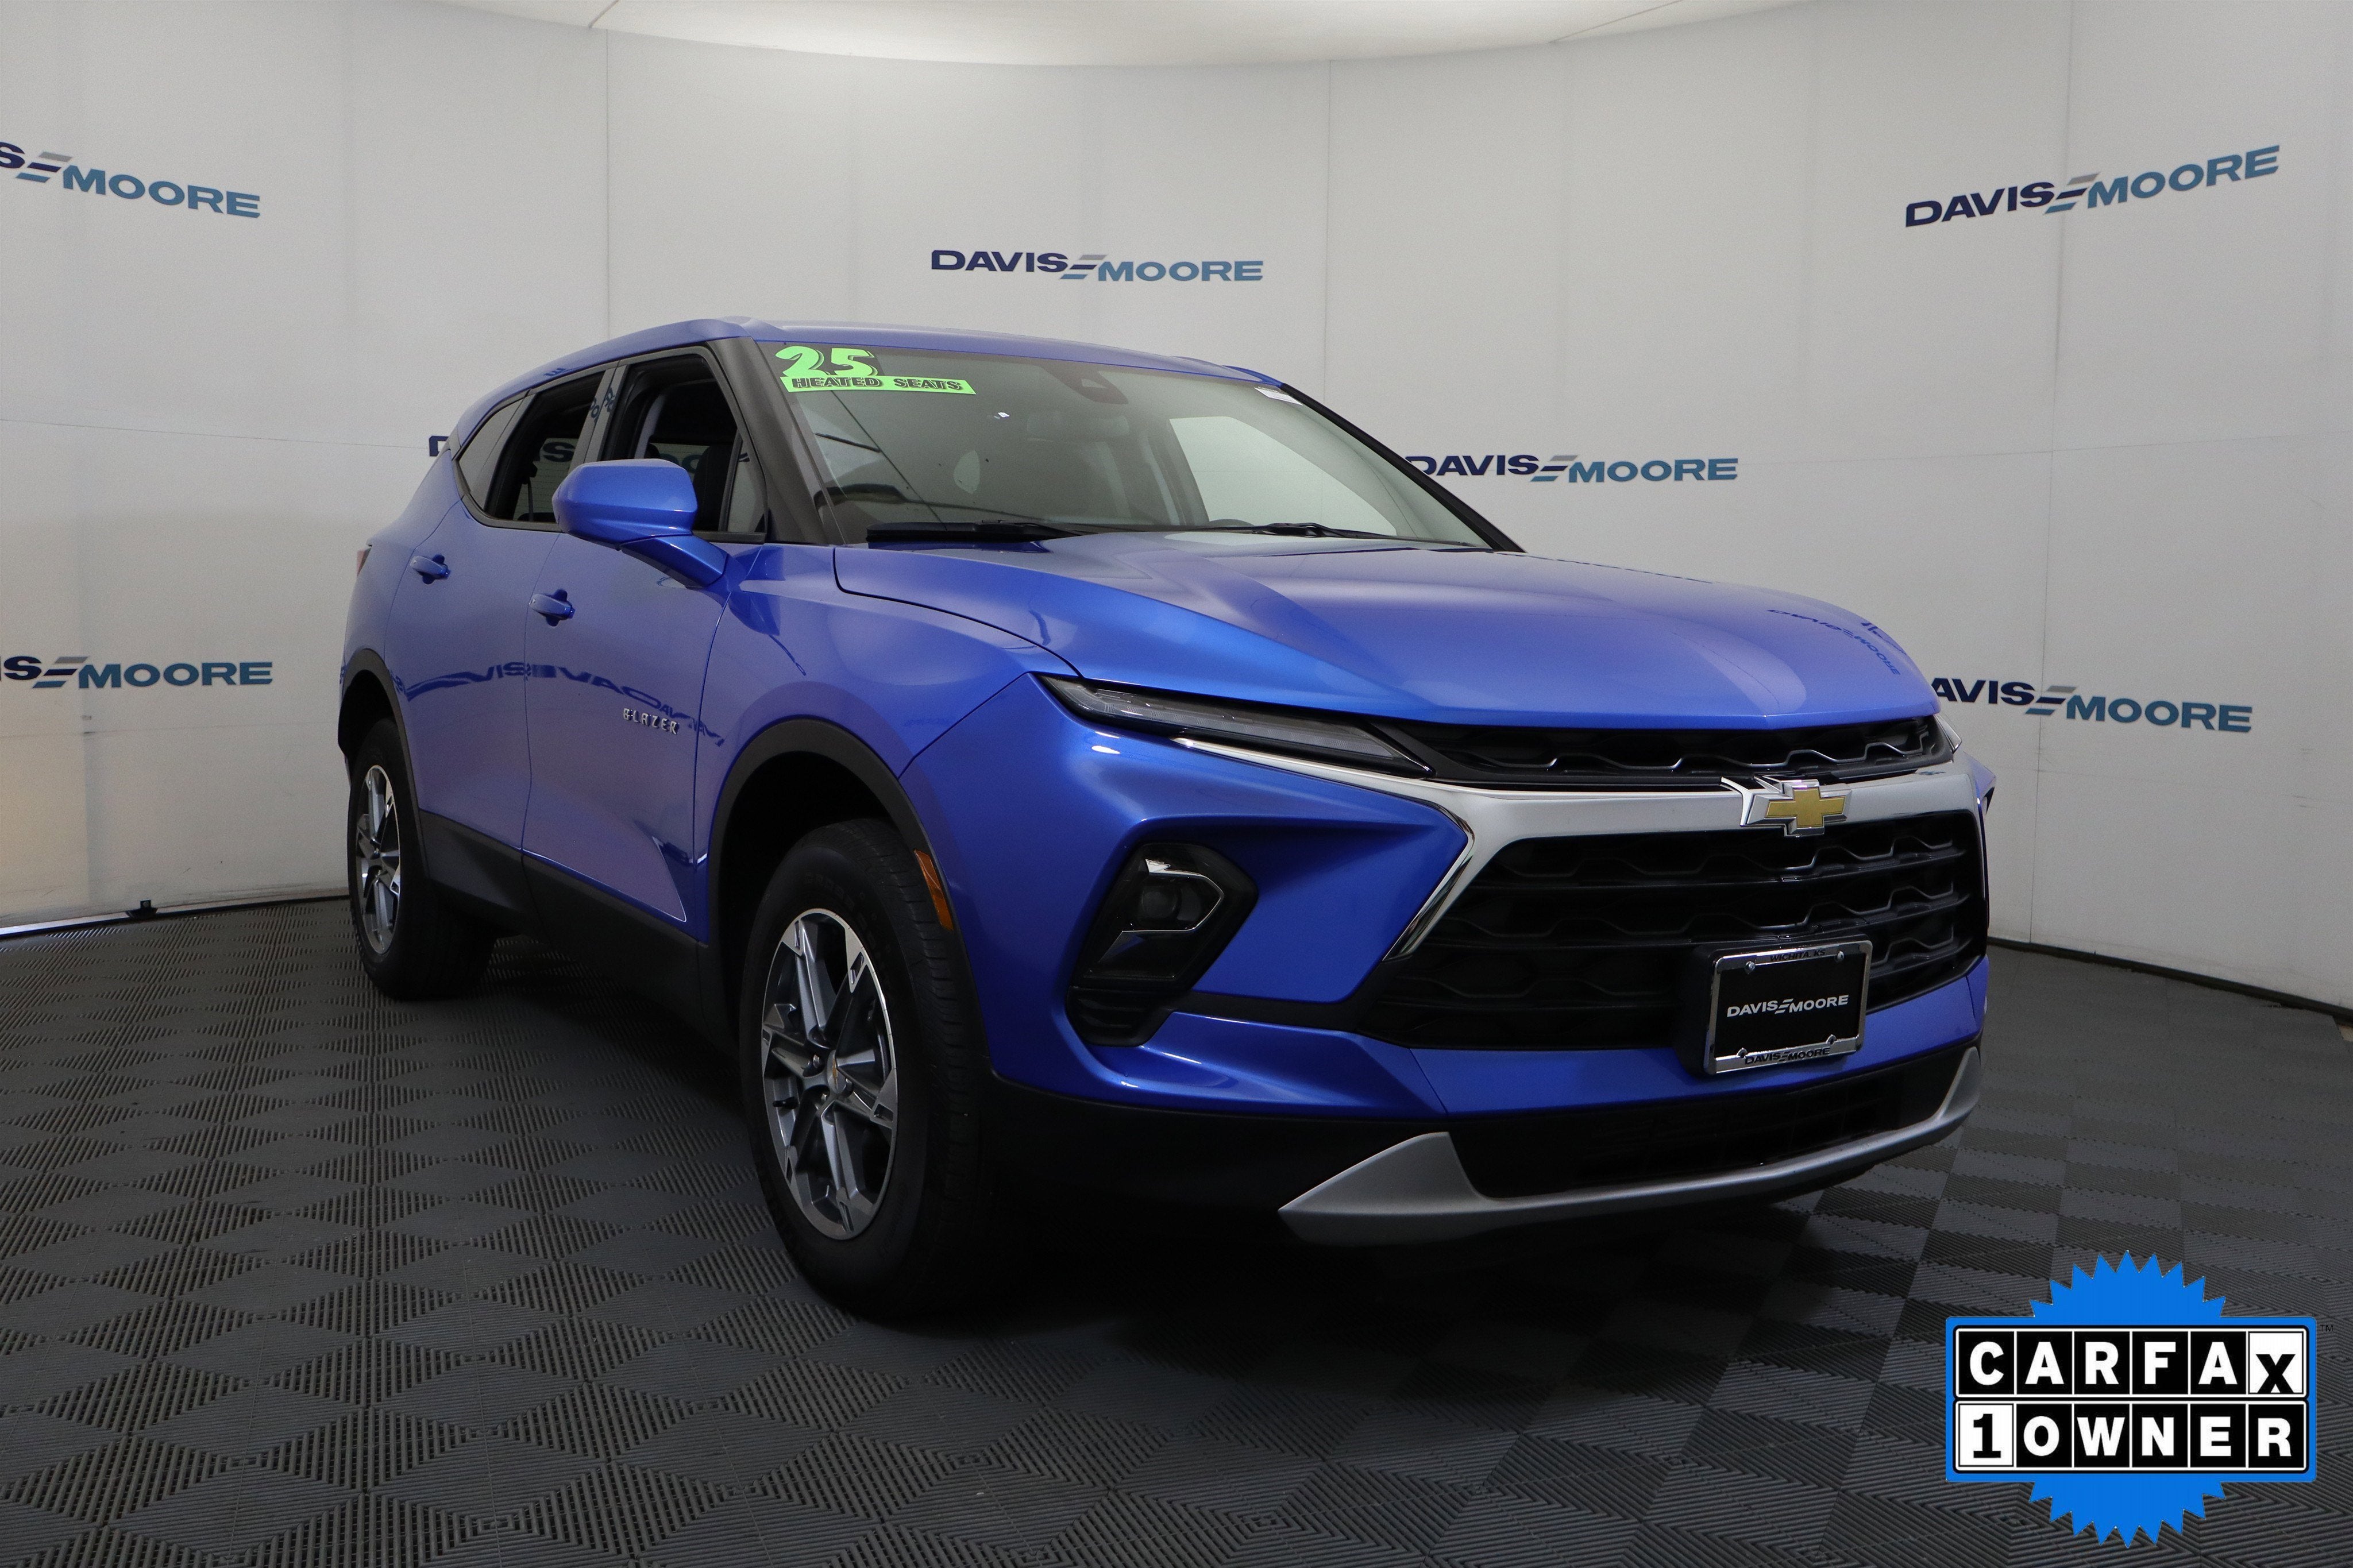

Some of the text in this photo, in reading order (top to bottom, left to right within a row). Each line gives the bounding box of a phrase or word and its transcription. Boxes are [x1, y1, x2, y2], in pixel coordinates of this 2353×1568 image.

[63, 165, 260, 218] MOORE
[1905, 145, 2280, 227] DAVIS MOORE
[931, 250, 1263, 281] DAVIS MOORE
[775, 346, 878, 376] 25
[792, 377, 963, 390] HEATED SEATS
[1405, 454, 1738, 483] DAVIS MOORE
[78, 662, 273, 689] MOORE
[1931, 677, 2252, 733] AVIS MOORE
[623, 708, 678, 735] BLAZER
[1727, 994, 1849, 1017] DAVIS MOORE
[1745, 1046, 1831, 1064] DAVIS MOORE
